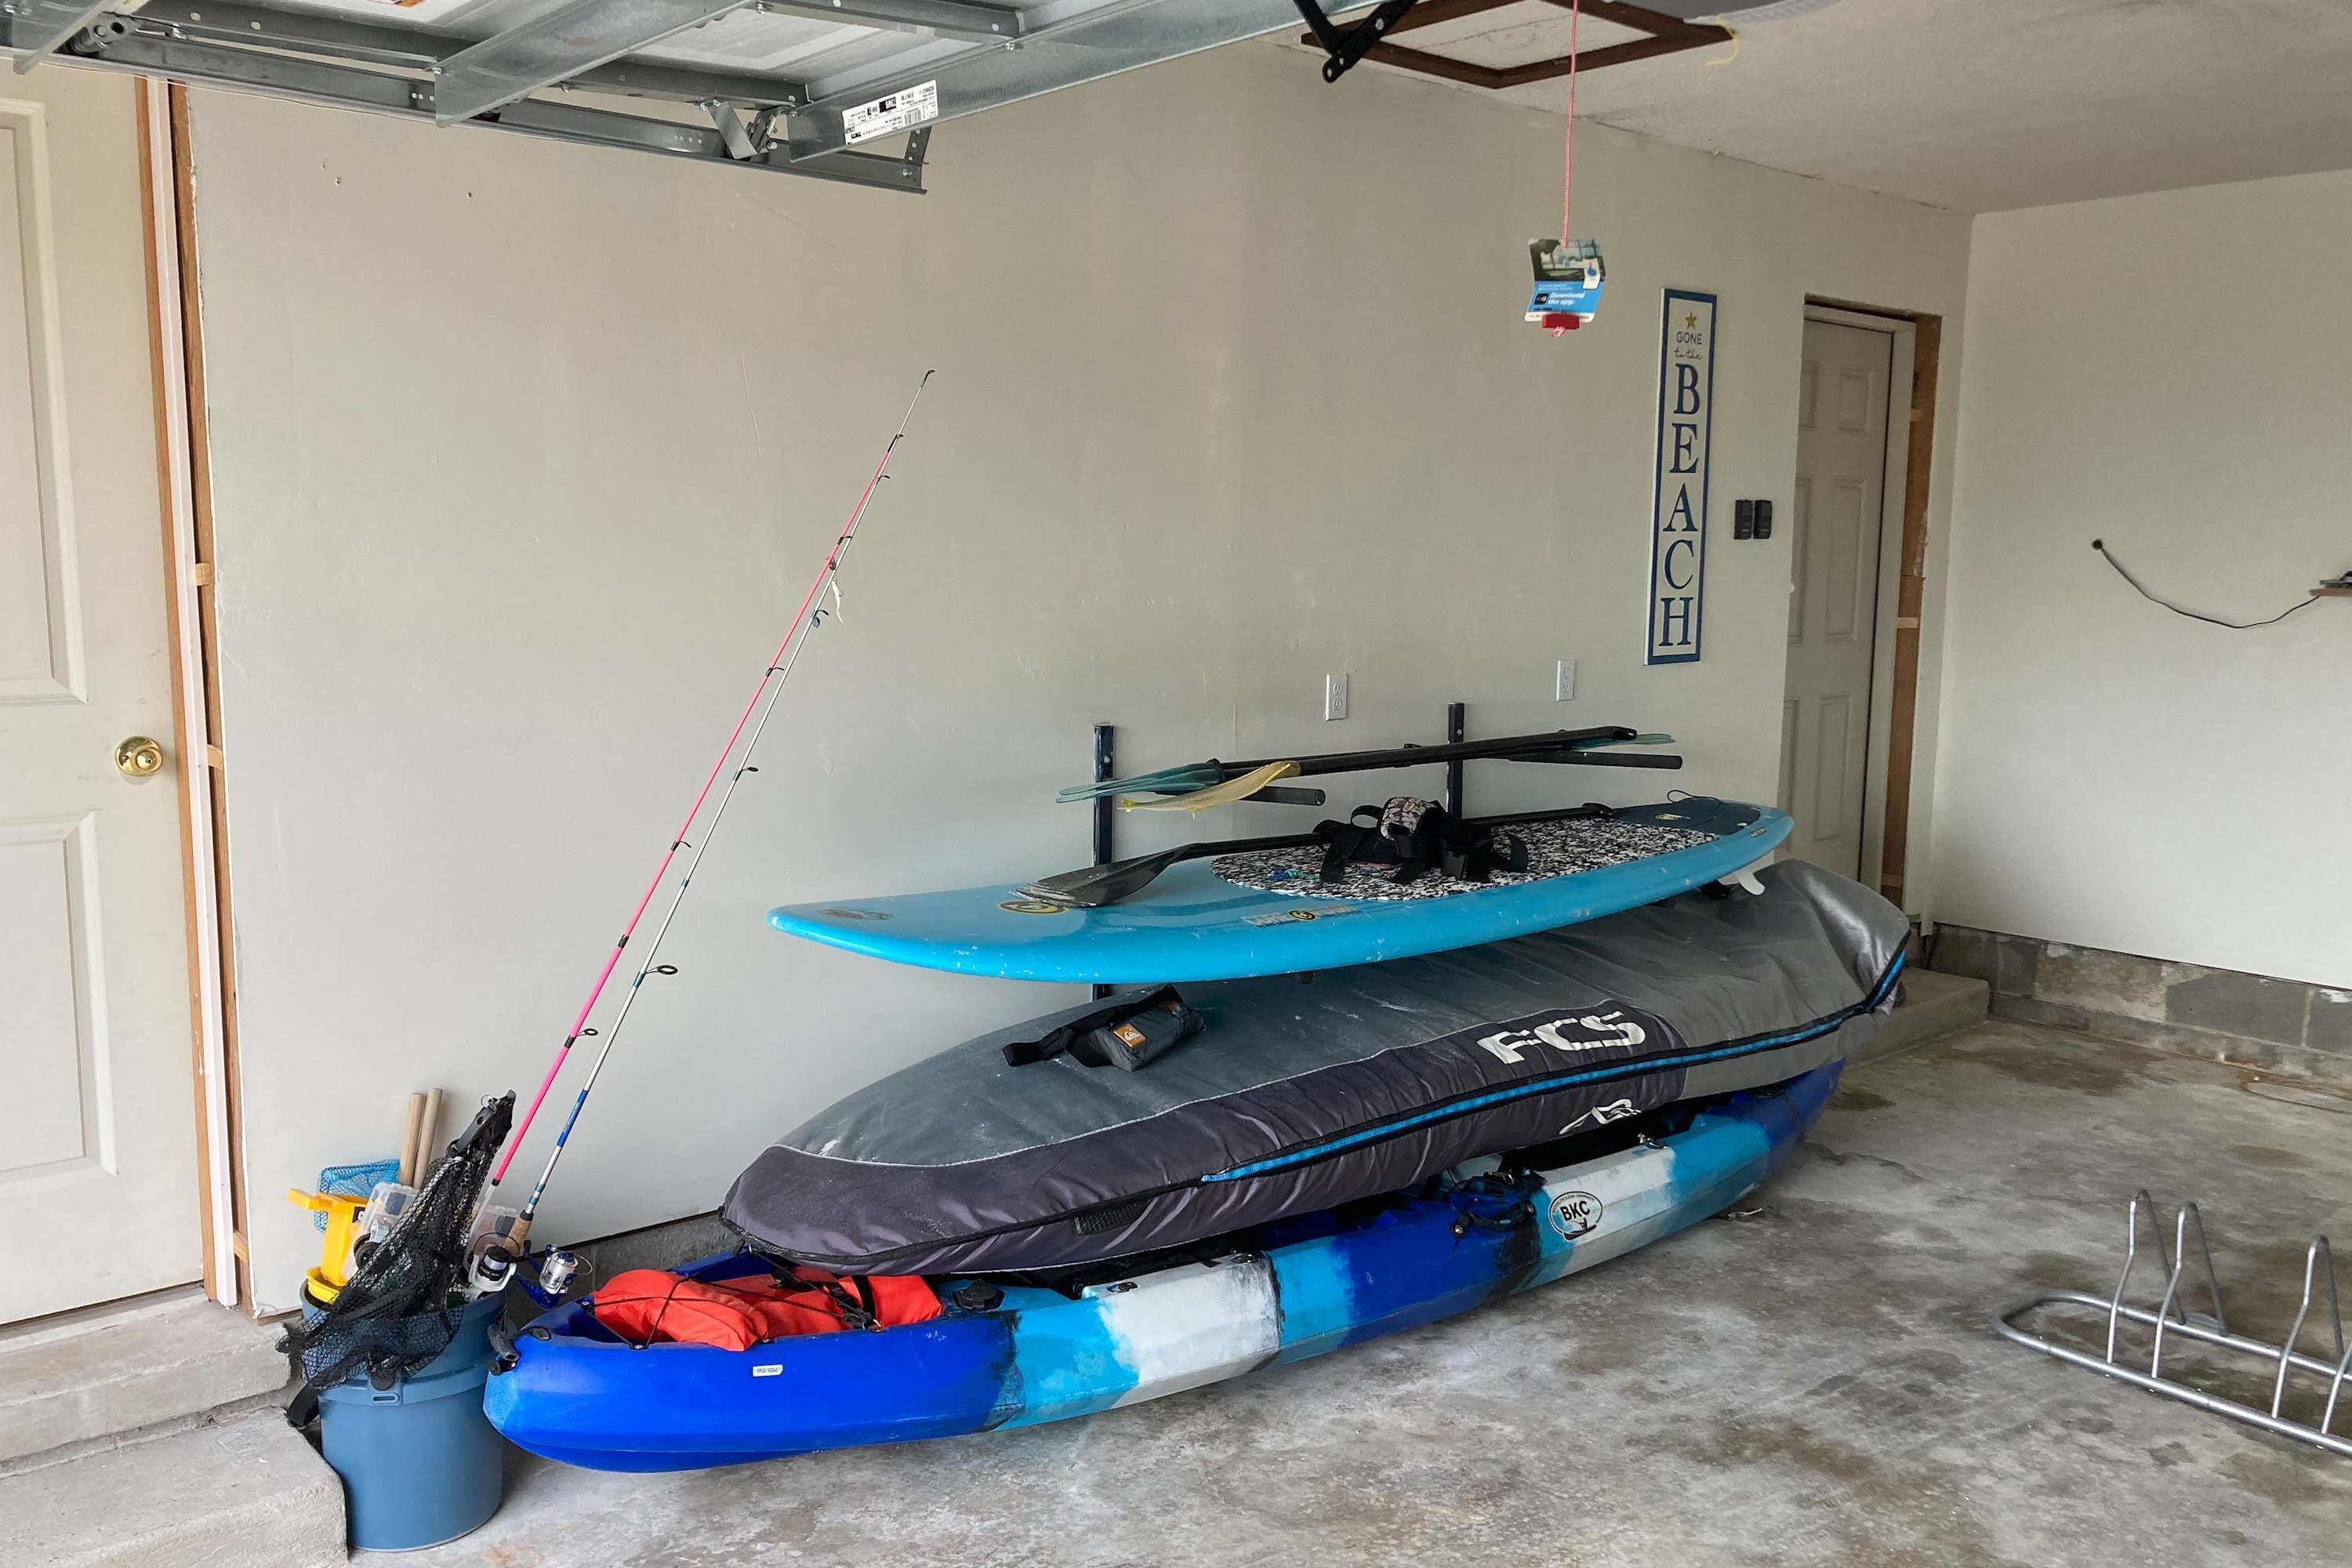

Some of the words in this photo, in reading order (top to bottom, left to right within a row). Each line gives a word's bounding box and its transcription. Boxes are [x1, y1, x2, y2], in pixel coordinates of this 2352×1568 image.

[1676, 332, 1702, 345] GONE
[1658, 362, 1700, 647] BEACH
[1476, 1011, 1646, 1065] FCS
[1559, 1200, 1591, 1221] BKC
